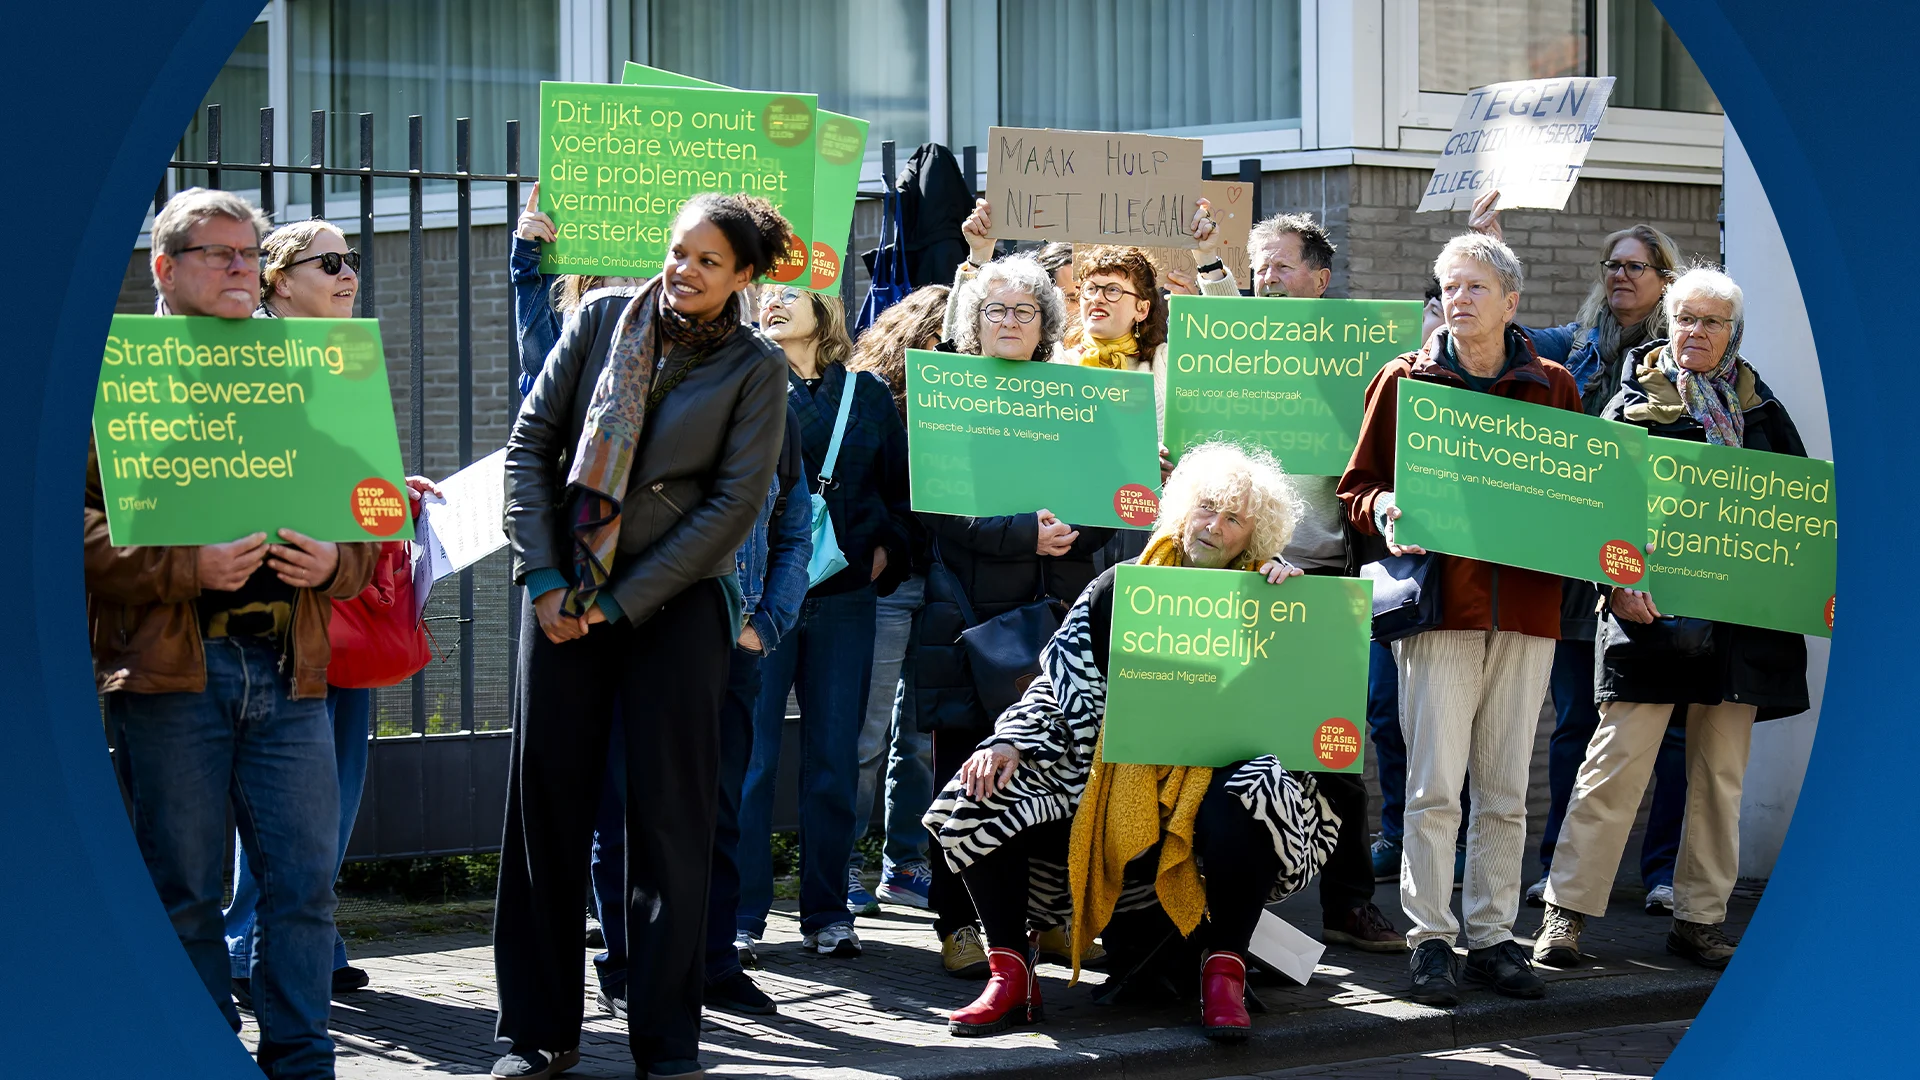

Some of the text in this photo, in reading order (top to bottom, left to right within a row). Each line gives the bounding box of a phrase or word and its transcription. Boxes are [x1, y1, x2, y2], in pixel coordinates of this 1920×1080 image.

[1469, 81, 1591, 121] TEGEN
[552, 100, 591, 124] ‘Dit
[602, 103, 642, 131] lijkt
[650, 111, 683, 132] op
[692, 109, 755, 132] onuit
[551, 132, 757, 160] voerbare wetten
[1000, 136, 1074, 177] MAAK
[551, 160, 788, 192] die problemen niet
[550, 190, 688, 214] vermindere
[1006, 188, 1196, 238] NIET ILLEGAAL
[548, 254, 664, 268] Nationale Ombudsma
[812, 249, 826, 258] OP
[811, 266, 835, 278] TTEN
[1180, 312, 1334, 342] 'Noodzaak
[1343, 317, 1398, 344] niet
[105, 336, 344, 374] Strafbaarstelling
[1177, 348, 1369, 376] onderbouwd'
[102, 374, 305, 404] niet bewezen
[917, 363, 1130, 402] 'Grote zorgen over
[1176, 387, 1302, 400] Raad voor de Rechtspraak
[918, 390, 1098, 423] uitvoerbaarheid'
[108, 412, 244, 445] effectief,
[918, 420, 1060, 441] Inspectie Justitie & Veiligheid
[1408, 396, 1620, 459] ‘Onwerkbaar en
[112, 450, 297, 487] integendeel’
[1408, 432, 1604, 484] onuitvoerbaar’
[1406, 461, 1458, 482] Vereniging
[1462, 474, 1479, 484] van
[1482, 475, 1544, 497] Nederlandse
[1546, 488, 1604, 509] Gemeenten
[1648, 454, 1828, 504] ‘Onveiligheid
[357, 487, 384, 497] STOP
[358, 497, 402, 507] DE ASIEL
[1120, 490, 1142, 498] STOP
[1132, 498, 1156, 507] ASIEL
[359, 506, 403, 517] WETTEN
[1120, 504, 1156, 514] WETTEN
[1121, 511, 1134, 519] .NL
[1648, 496, 1837, 540] voor kinderen
[362, 516, 378, 526] .NL
[1606, 544, 1628, 555] STOP
[1606, 552, 1641, 567] DE ASIEL
[1606, 559, 1641, 574] WETTEN
[1606, 567, 1620, 576] .NL
[1648, 563, 1728, 581] nderombudsman
[1124, 585, 1306, 628] ‘Onnodig en
[1122, 625, 1276, 666] schadelijk’
[1118, 668, 1217, 684] Adviesraad Migratie
[1320, 734, 1357, 744] DE ASIEL
[1322, 726, 1344, 734] STOP
[1319, 752, 1333, 760] .NL
[1320, 742, 1357, 753] WETTEN
